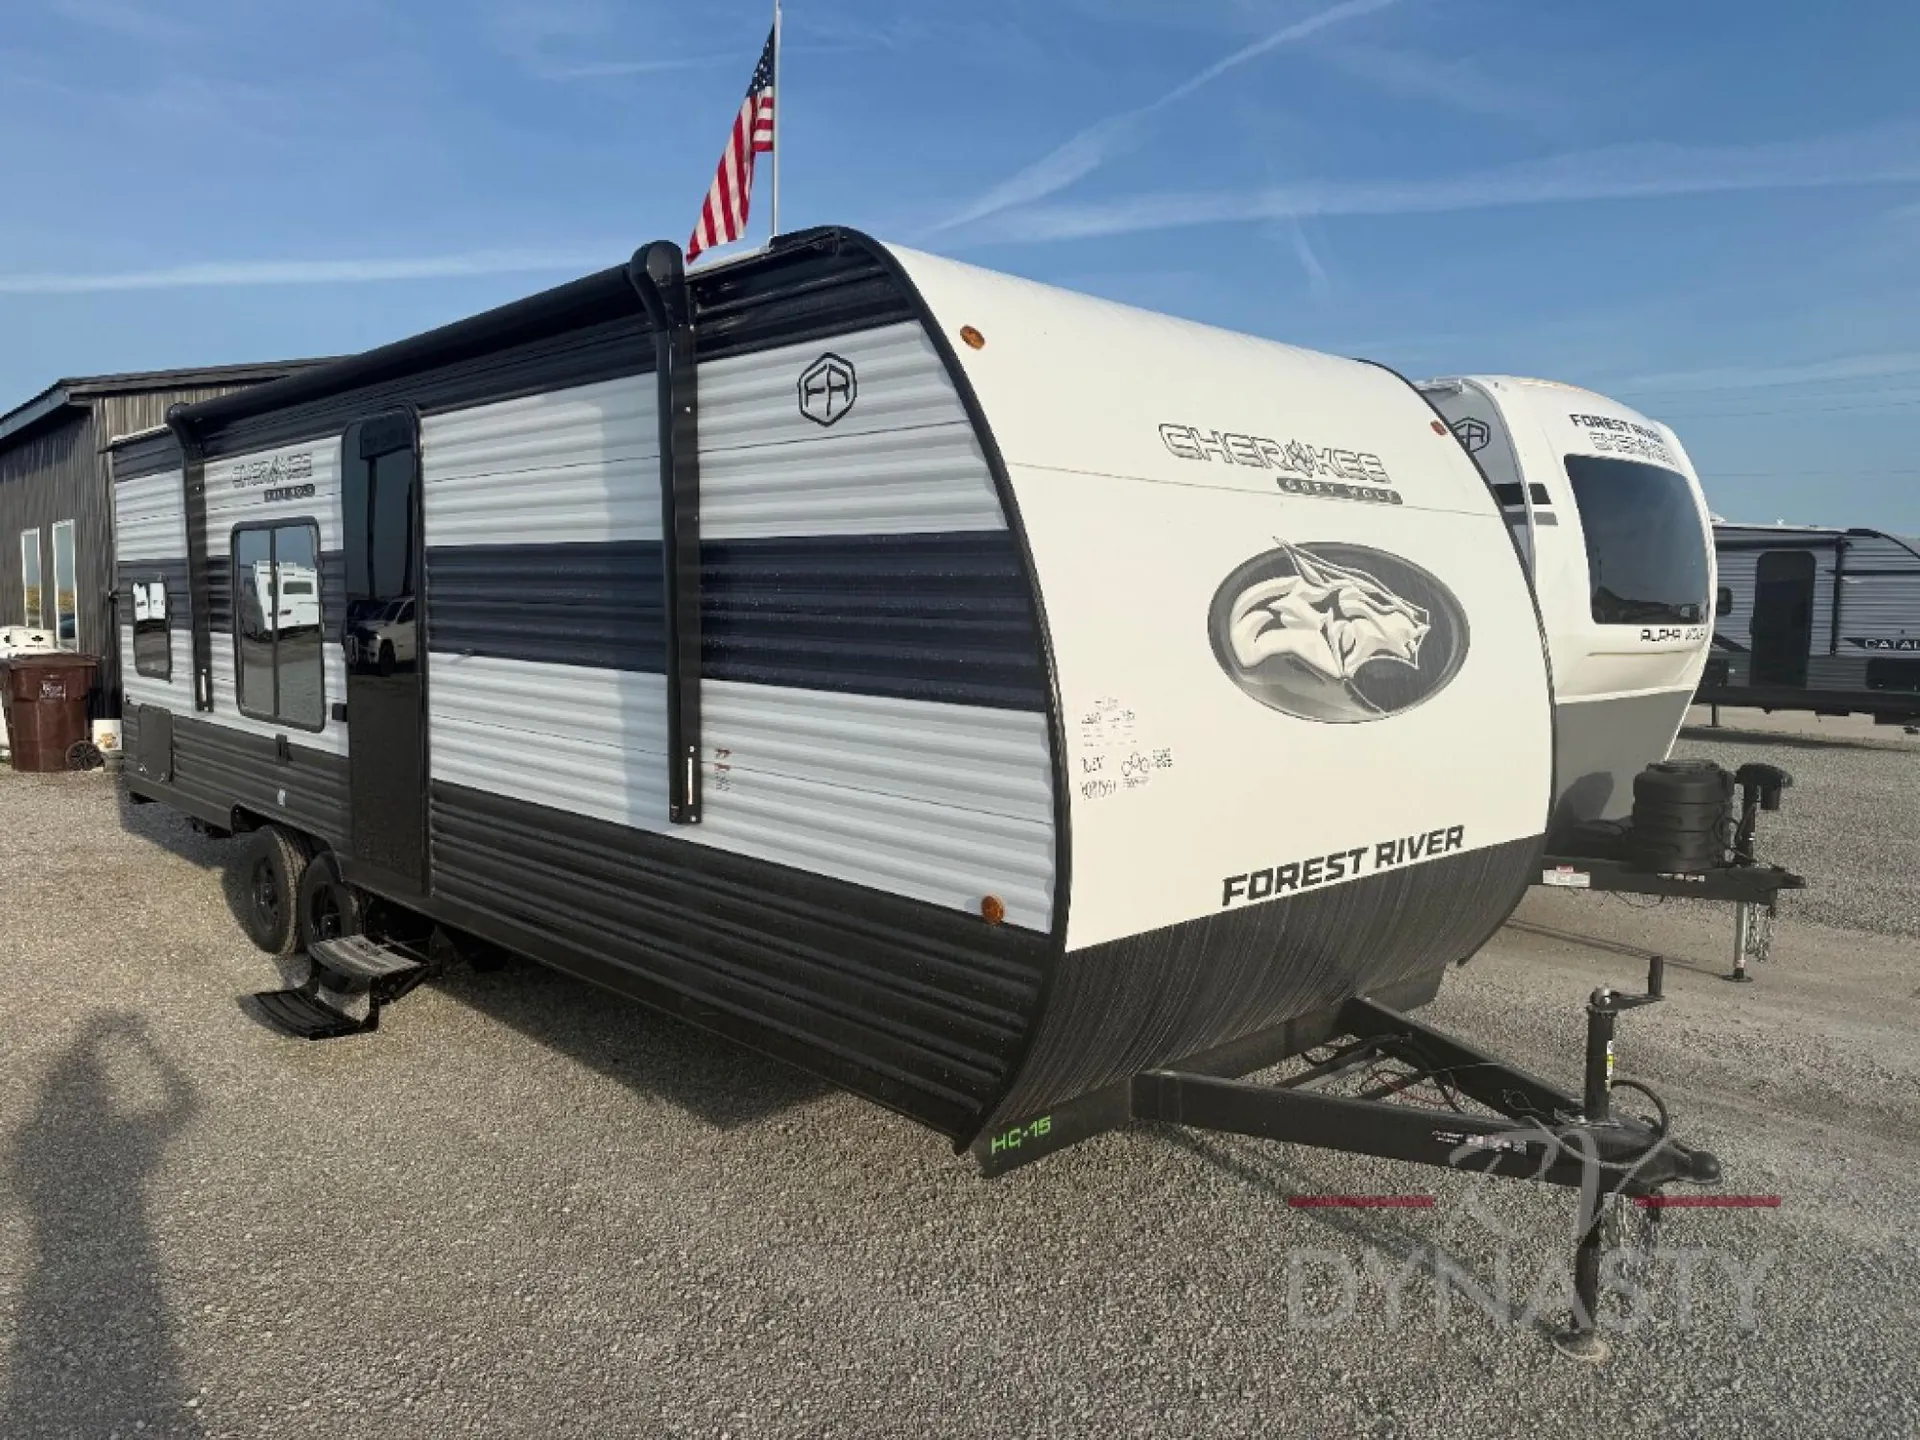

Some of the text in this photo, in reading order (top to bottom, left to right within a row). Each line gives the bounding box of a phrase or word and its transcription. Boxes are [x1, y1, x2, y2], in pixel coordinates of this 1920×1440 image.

[1158, 423, 1392, 484] CHEROKEE
[1222, 824, 1465, 907] FOREST RIVER
